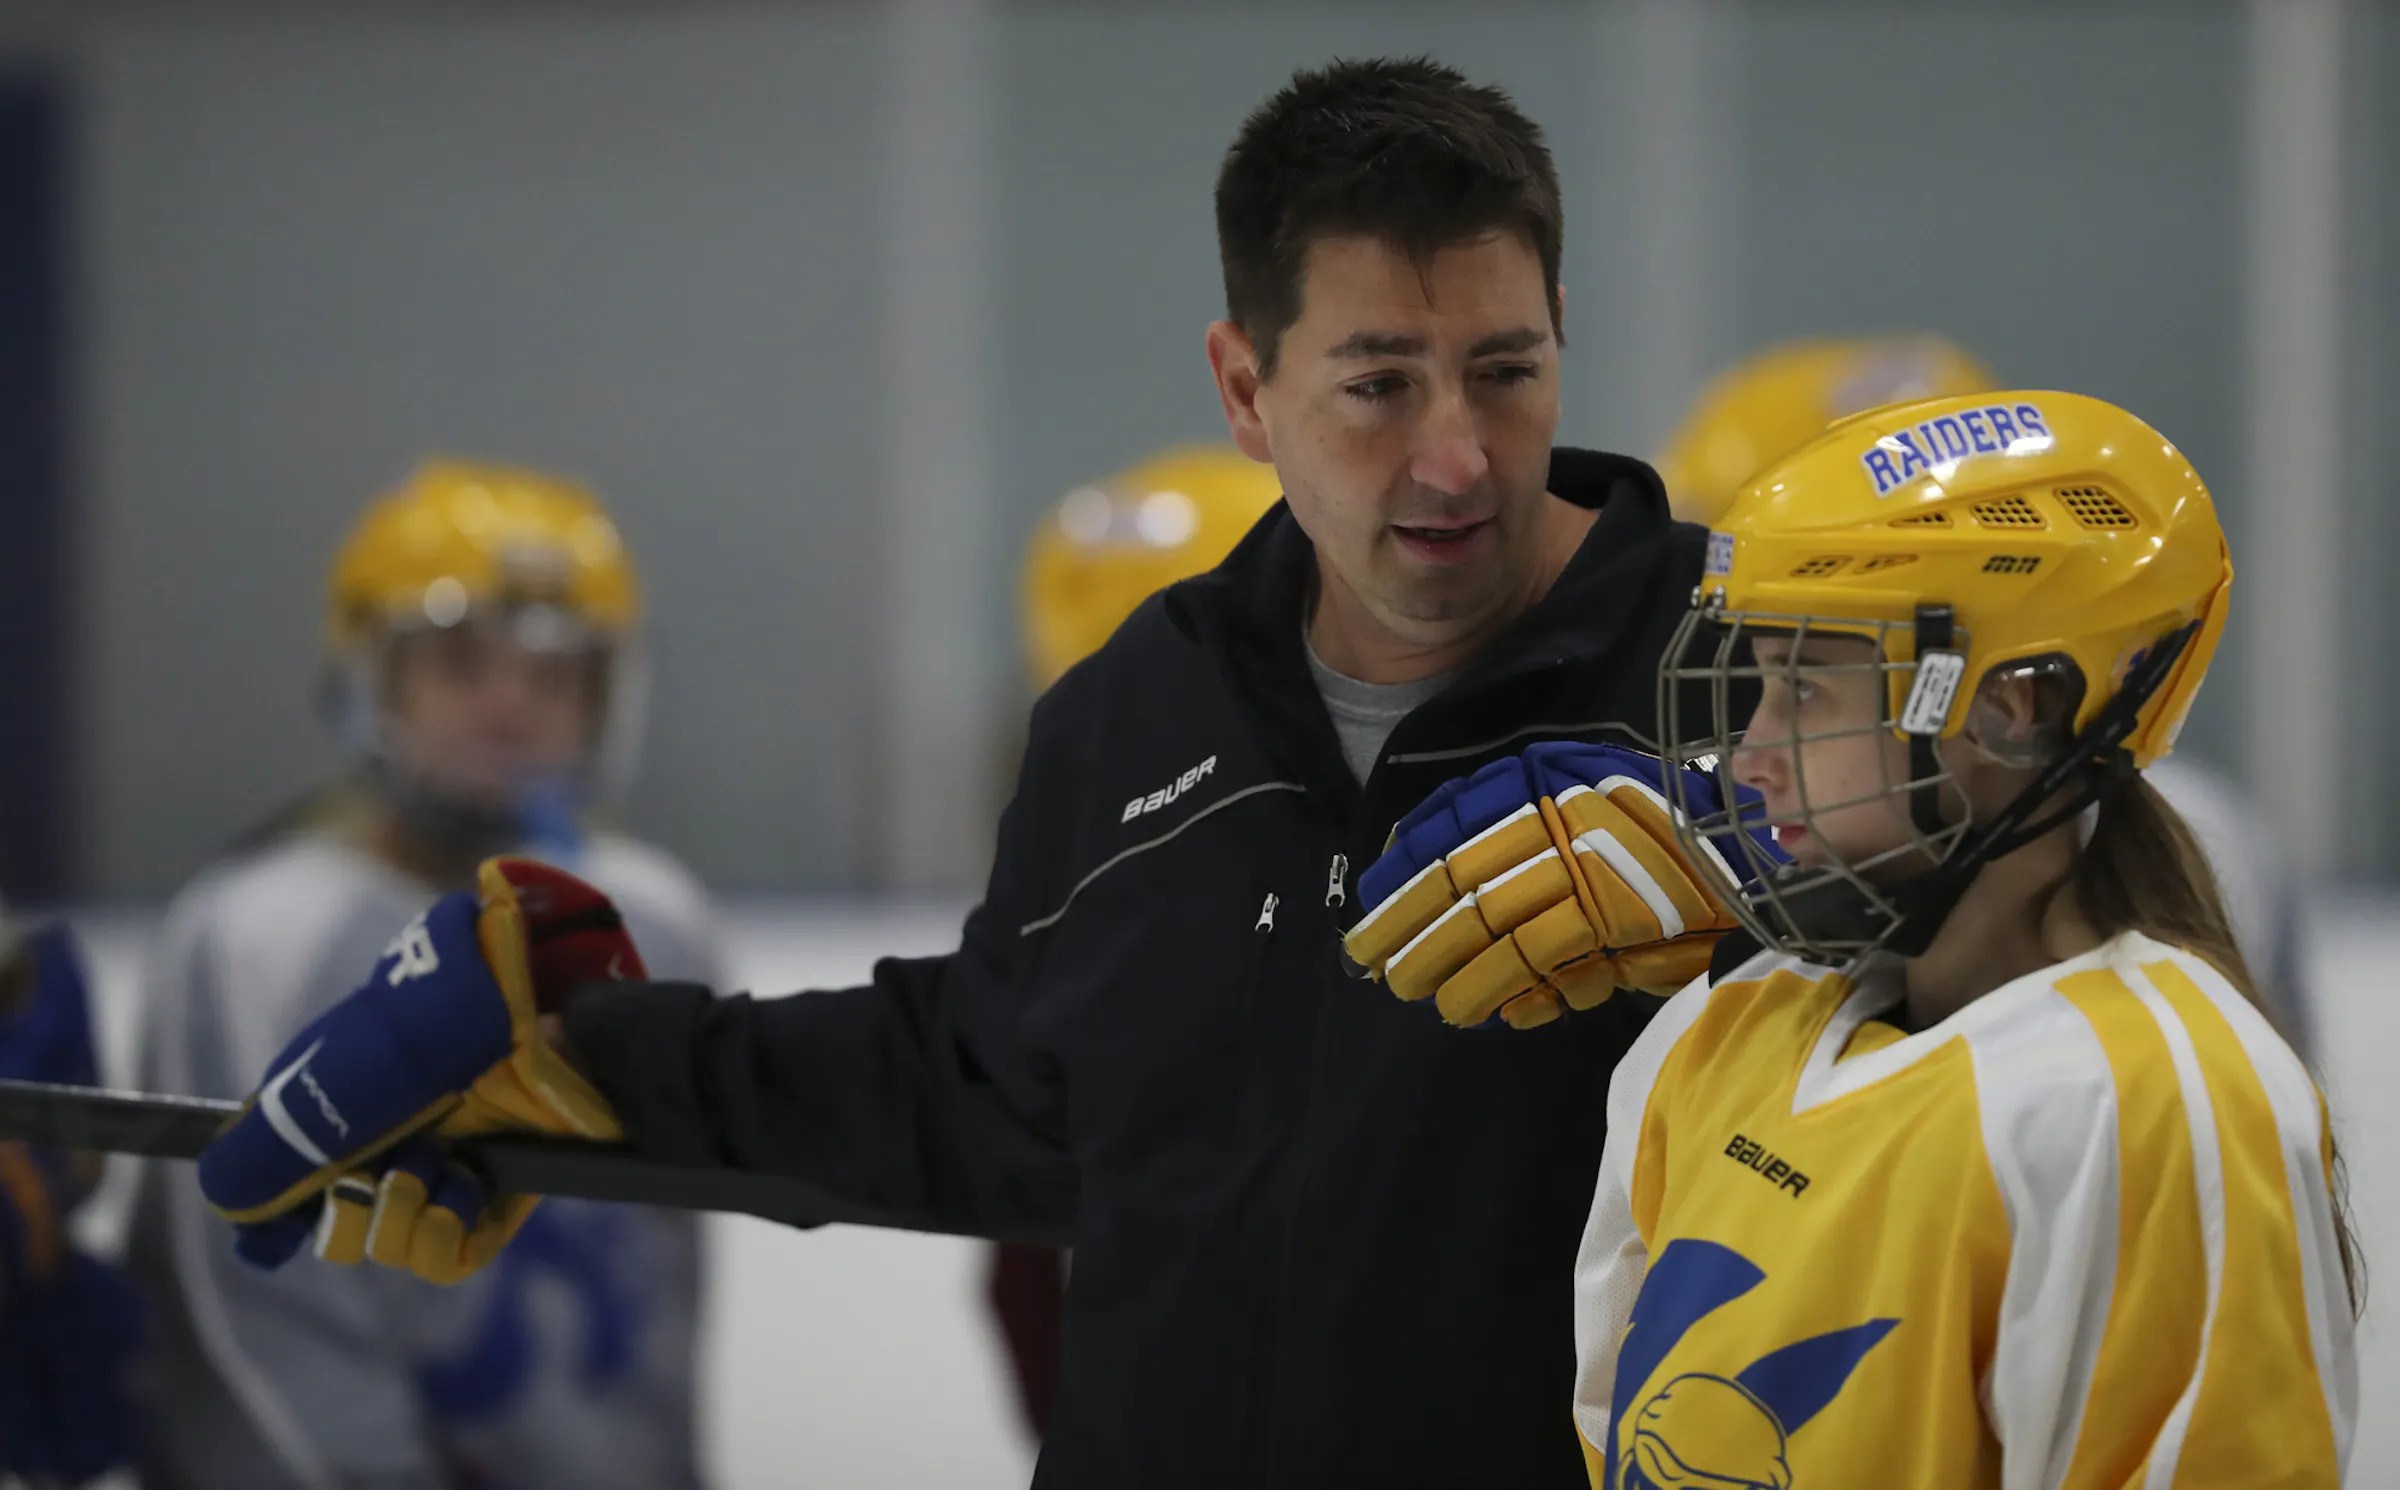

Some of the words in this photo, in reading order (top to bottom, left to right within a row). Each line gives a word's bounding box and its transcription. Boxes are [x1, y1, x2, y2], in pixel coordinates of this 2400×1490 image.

[1864, 404, 2052, 492] RAIDERS
[1121, 754, 1217, 824] BAUER
[1723, 1133, 1812, 1199] BAUER
